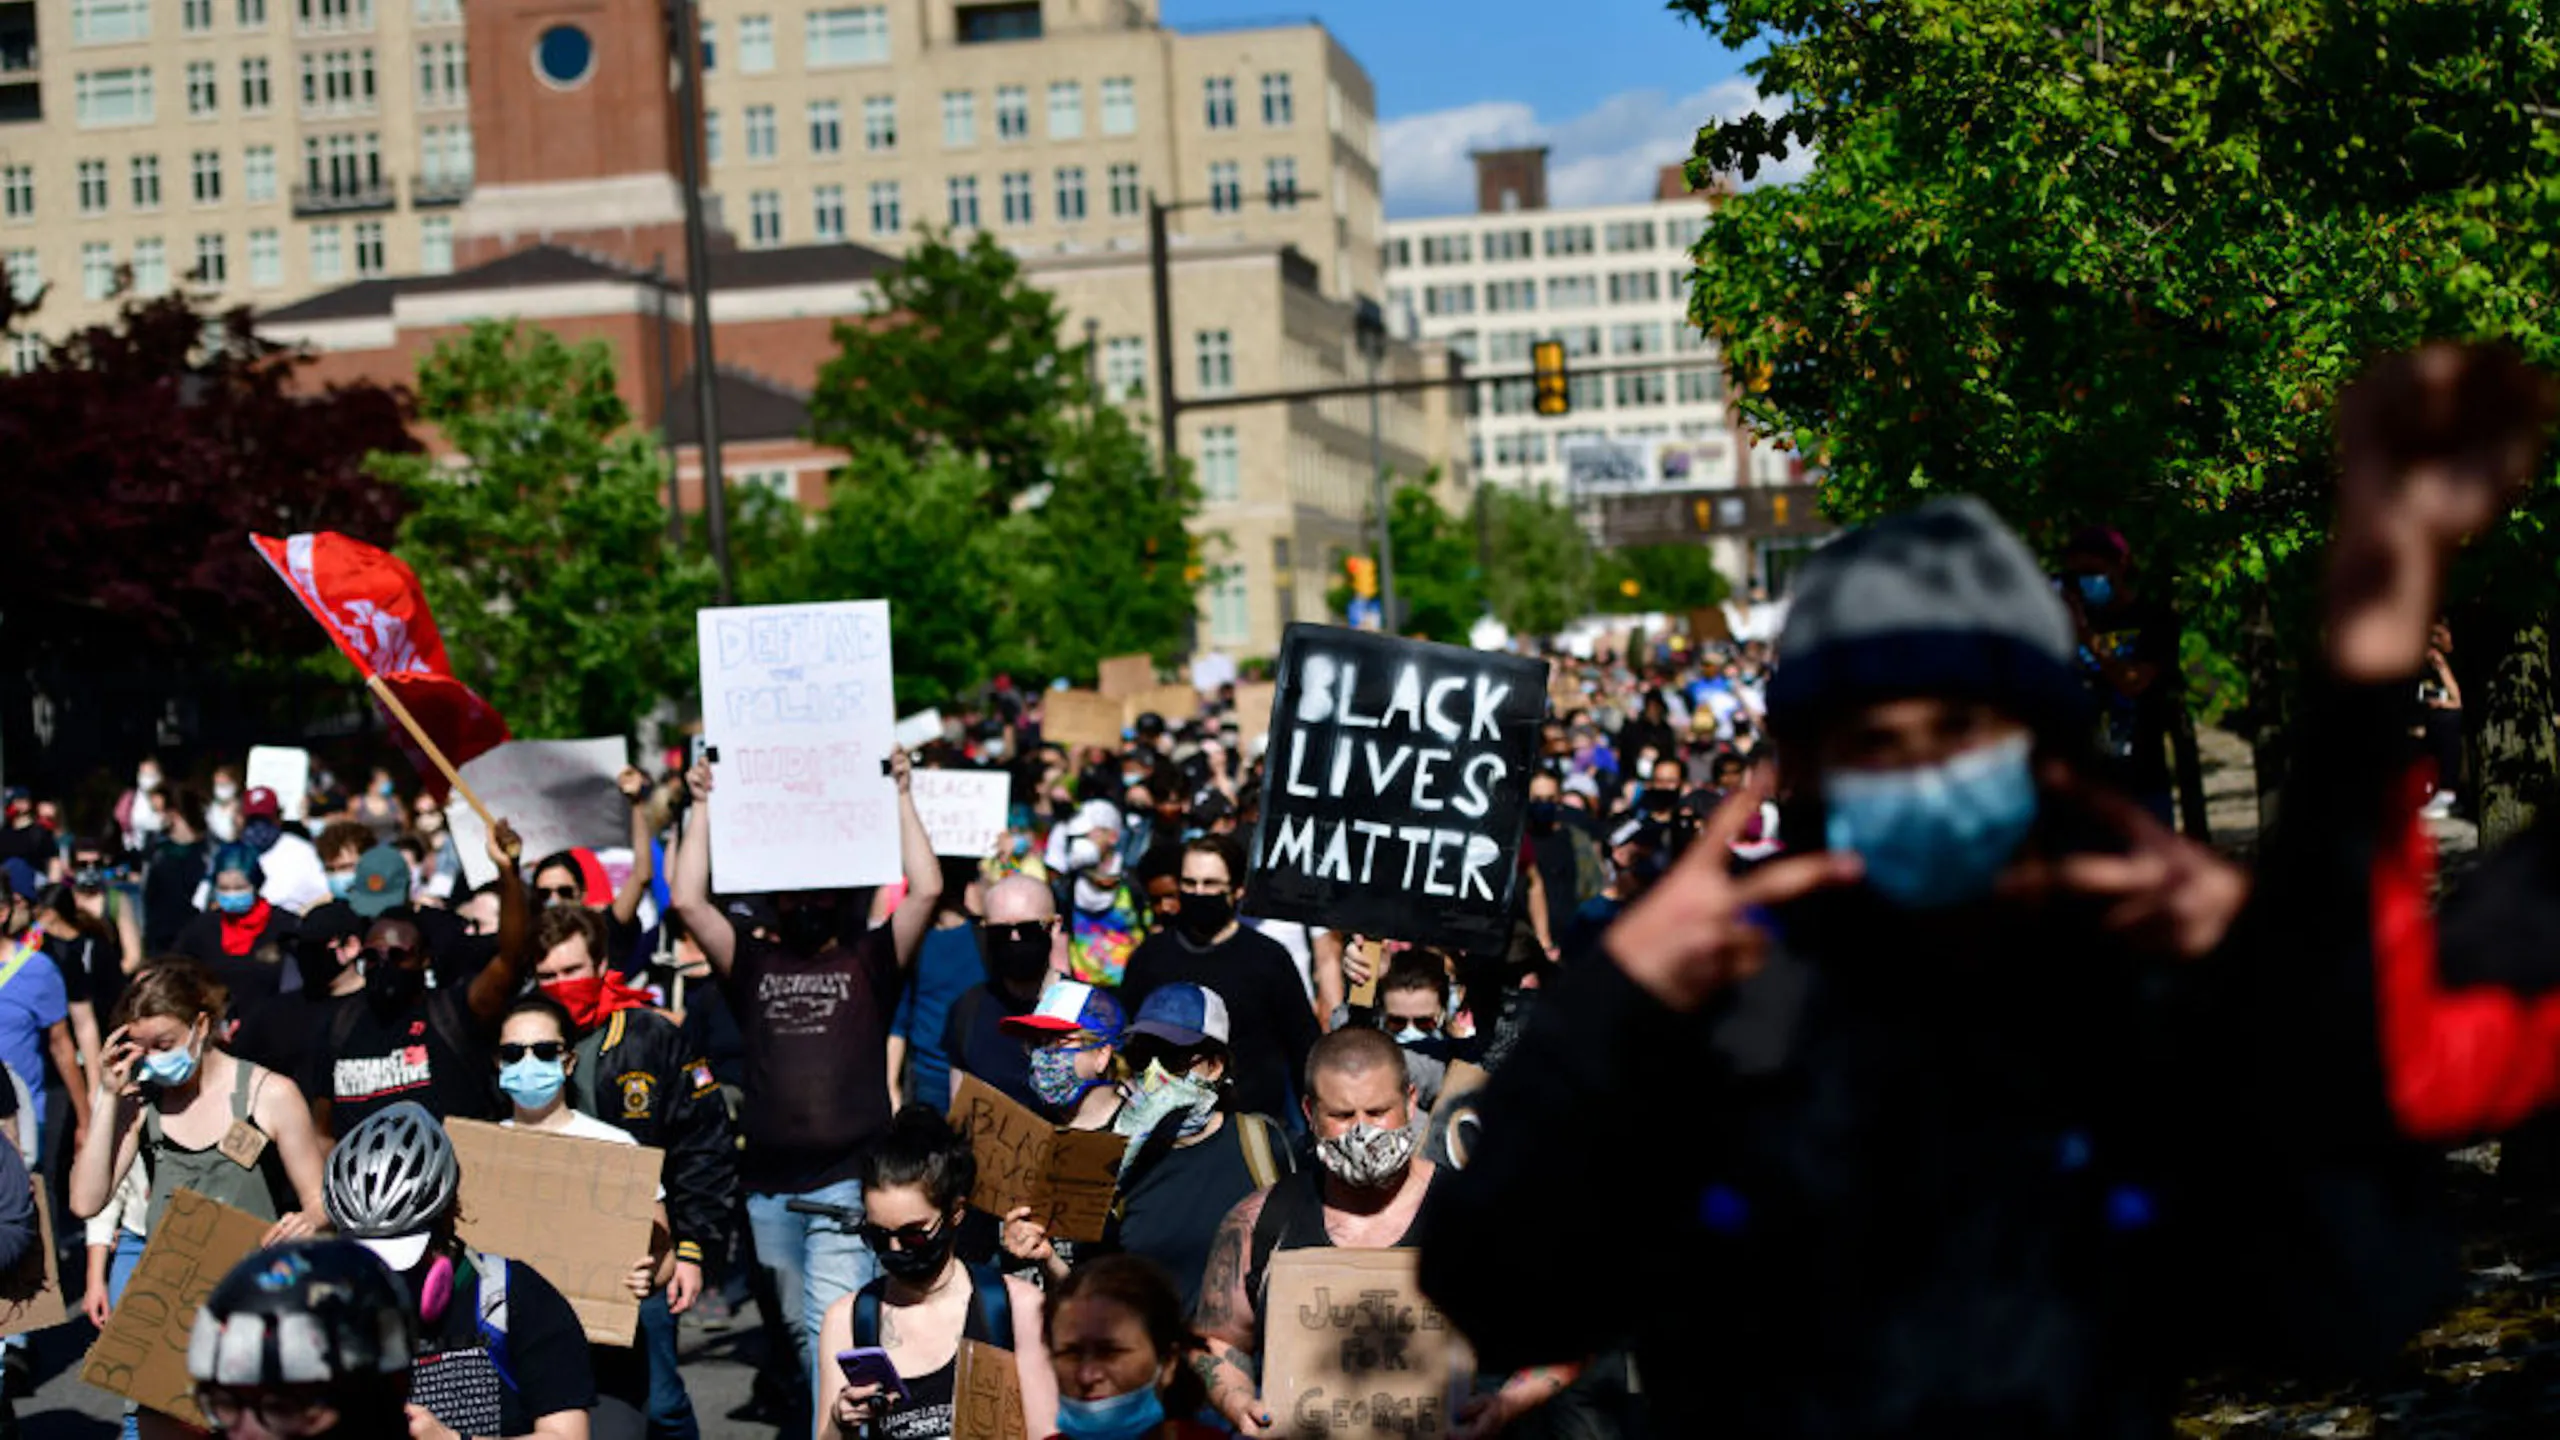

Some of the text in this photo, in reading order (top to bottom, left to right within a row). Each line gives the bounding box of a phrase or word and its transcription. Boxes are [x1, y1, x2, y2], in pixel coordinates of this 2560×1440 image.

[717, 612, 883, 669] DEFUND
[724, 680, 867, 727] POLICE
[1298, 654, 1510, 742] BLACK
[1286, 729, 1507, 819] LIVES
[1266, 813, 1500, 903] MATTER
[971, 1096, 1074, 1168] BLACK
[141, 1186, 222, 1289] EYES
